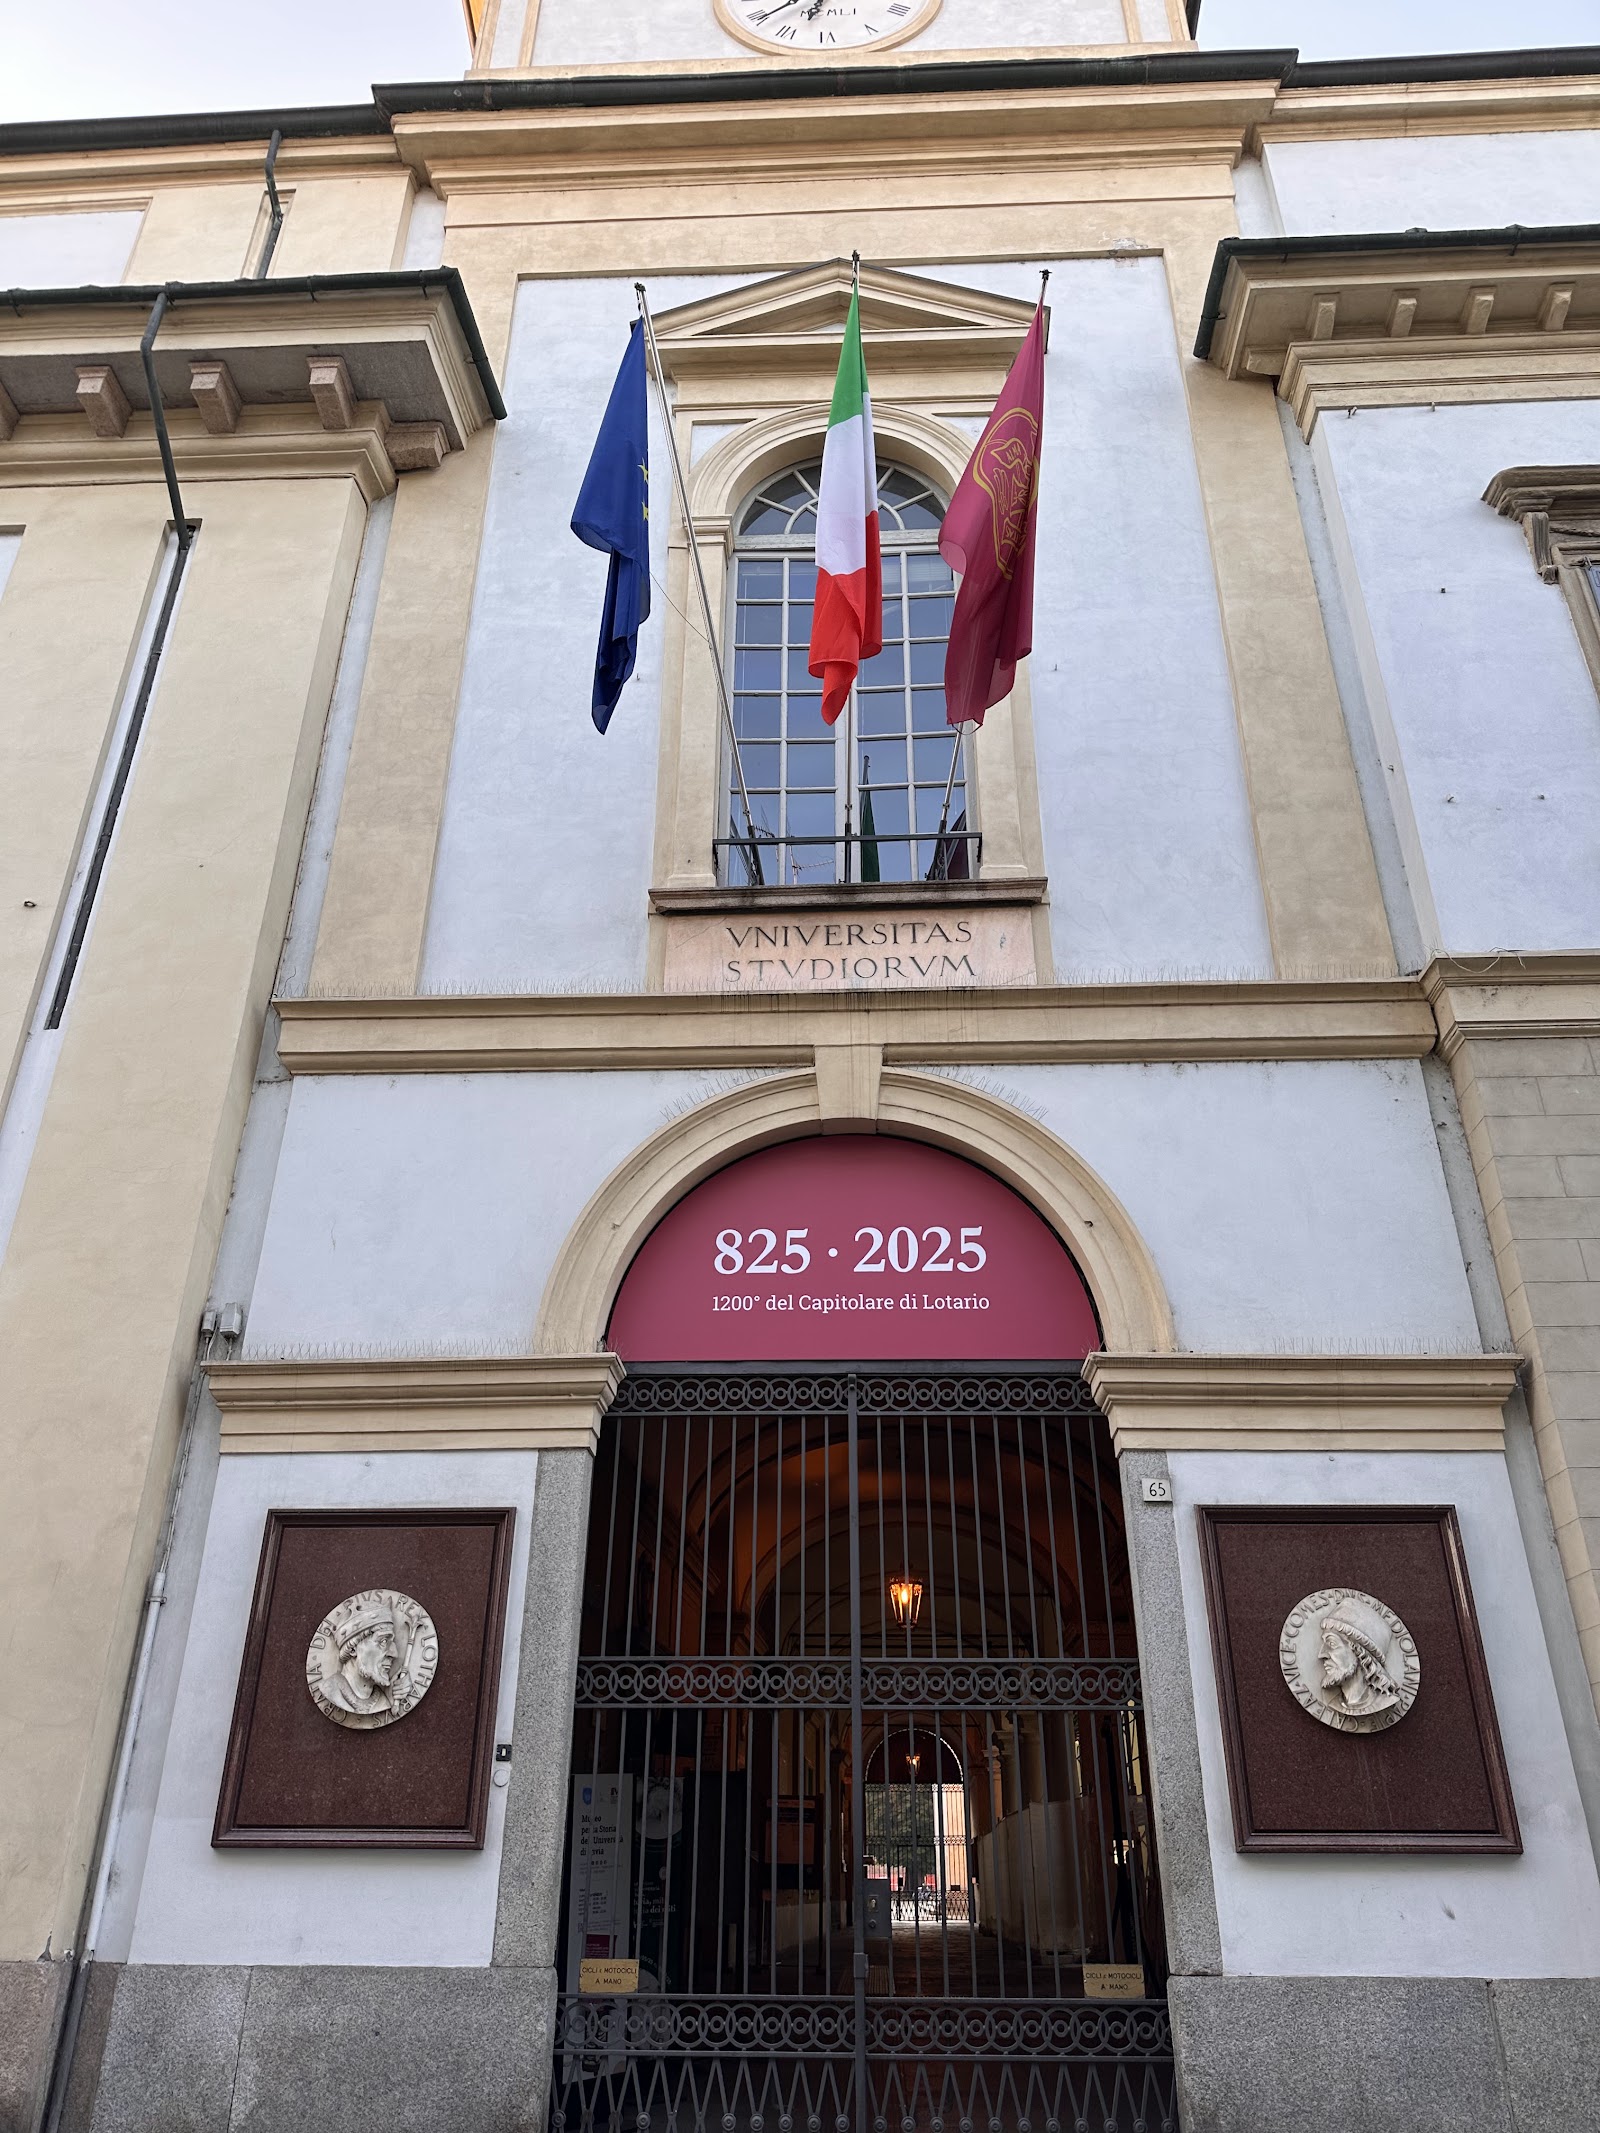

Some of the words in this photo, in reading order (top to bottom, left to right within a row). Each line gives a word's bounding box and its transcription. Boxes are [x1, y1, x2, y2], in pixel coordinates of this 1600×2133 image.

[726, 921, 972, 948] VNIVERSITAS
[725, 954, 977, 983] STVDIORVM
[713, 1228, 811, 1274] 825
[853, 1226, 987, 1273] 2025
[712, 1295, 760, 1311] 1200°
[765, 1294, 794, 1311] del
[798, 1293, 894, 1313] Capitolare
[899, 1293, 918, 1310] di
[922, 1293, 990, 1310] Lotario
[1149, 1482, 1166, 1497] 65
[582, 1966, 598, 1974] CICLI
[1108, 1972, 1142, 1980] MOTOCICLI
